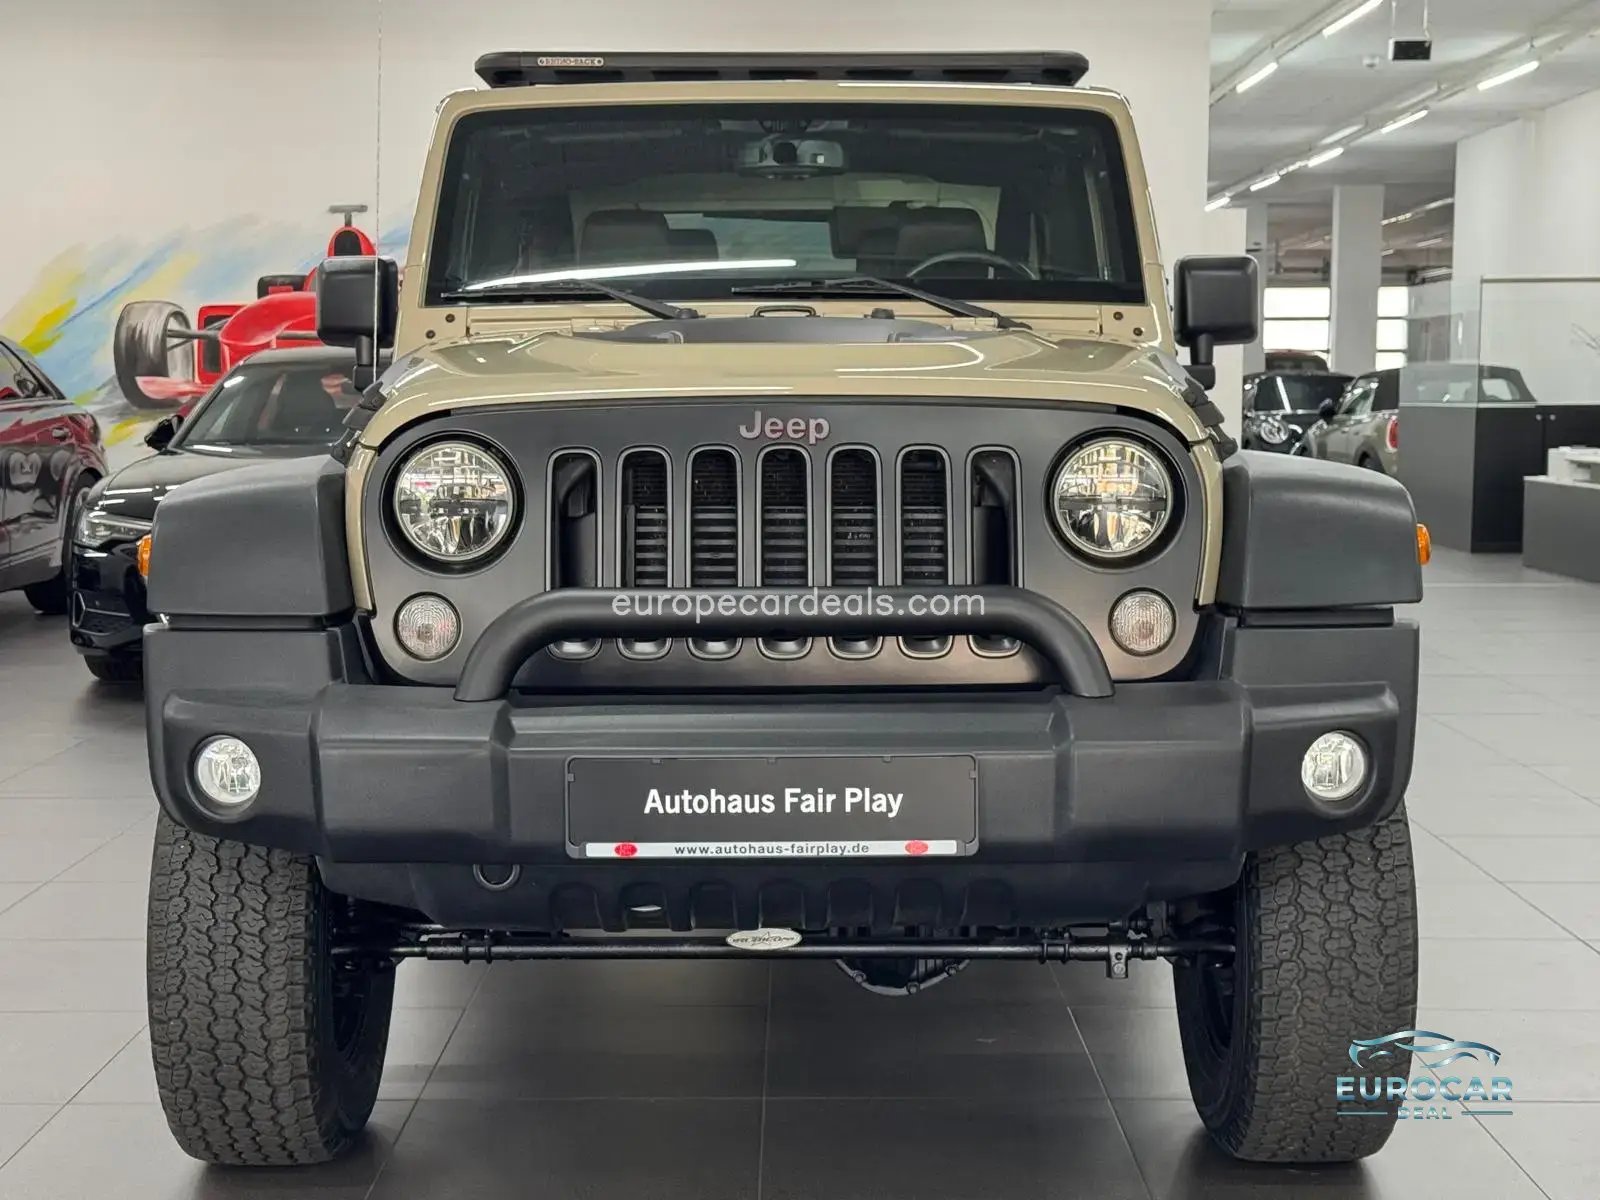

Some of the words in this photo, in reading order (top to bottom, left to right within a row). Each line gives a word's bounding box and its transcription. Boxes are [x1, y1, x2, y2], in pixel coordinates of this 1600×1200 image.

[739, 410, 830, 444] Jeep
[643, 788, 776, 814] Autohaus
[784, 787, 837, 813] Fair
[845, 787, 904, 818] Play
[674, 843, 870, 857] www.autohaus-fairplay.de
